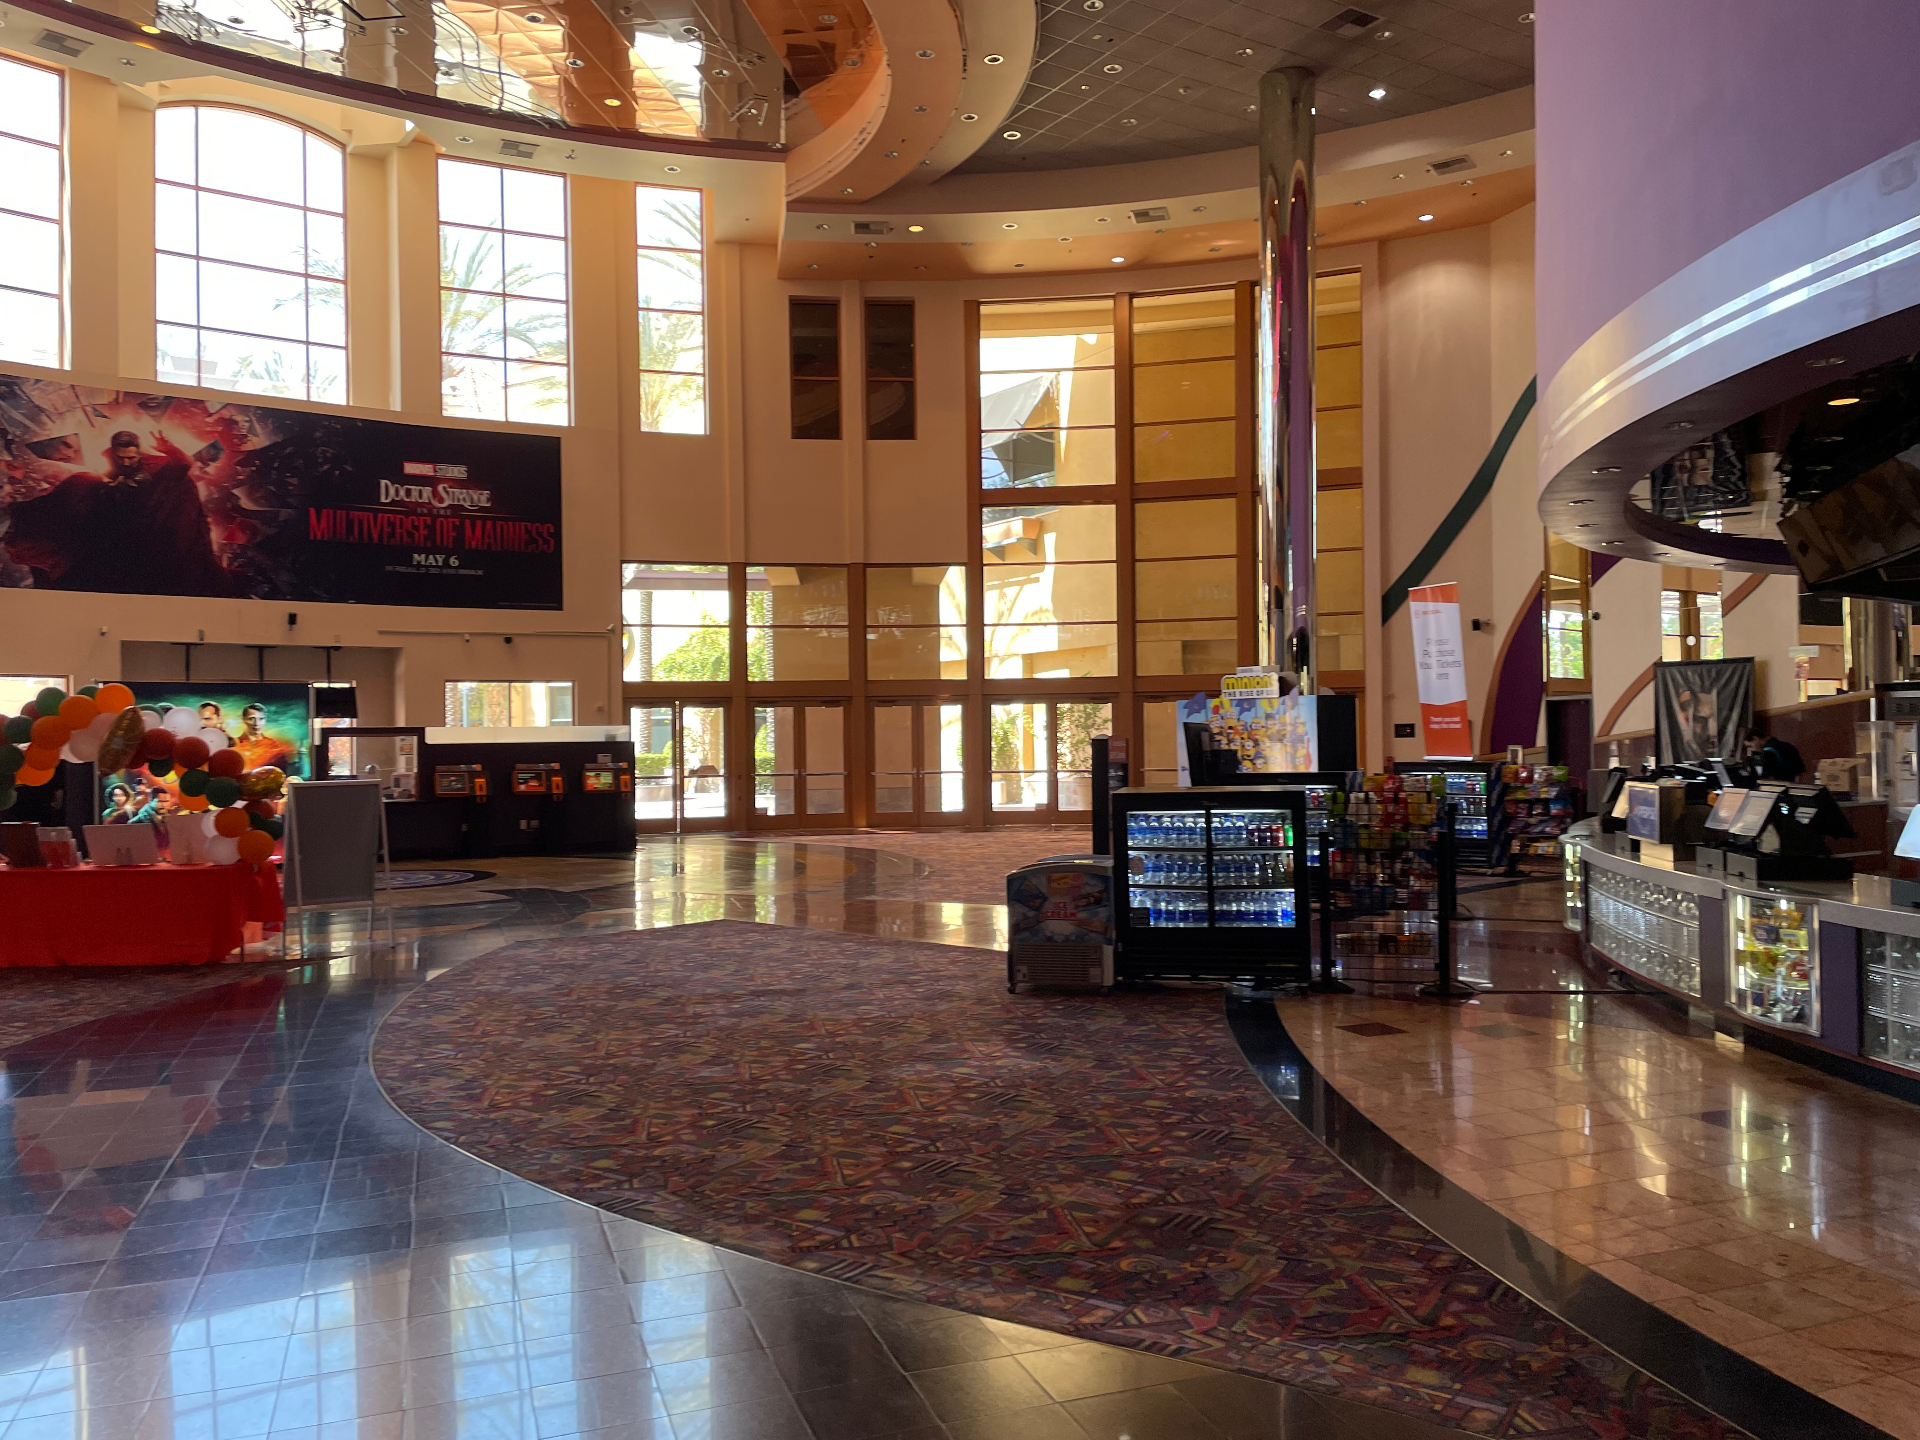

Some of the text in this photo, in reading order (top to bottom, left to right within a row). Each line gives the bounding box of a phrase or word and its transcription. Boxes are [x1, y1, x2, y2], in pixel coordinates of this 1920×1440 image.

[308, 507, 555, 553] MULTIVERSE OF MADNESS
[412, 553, 460, 567] MAY 6
